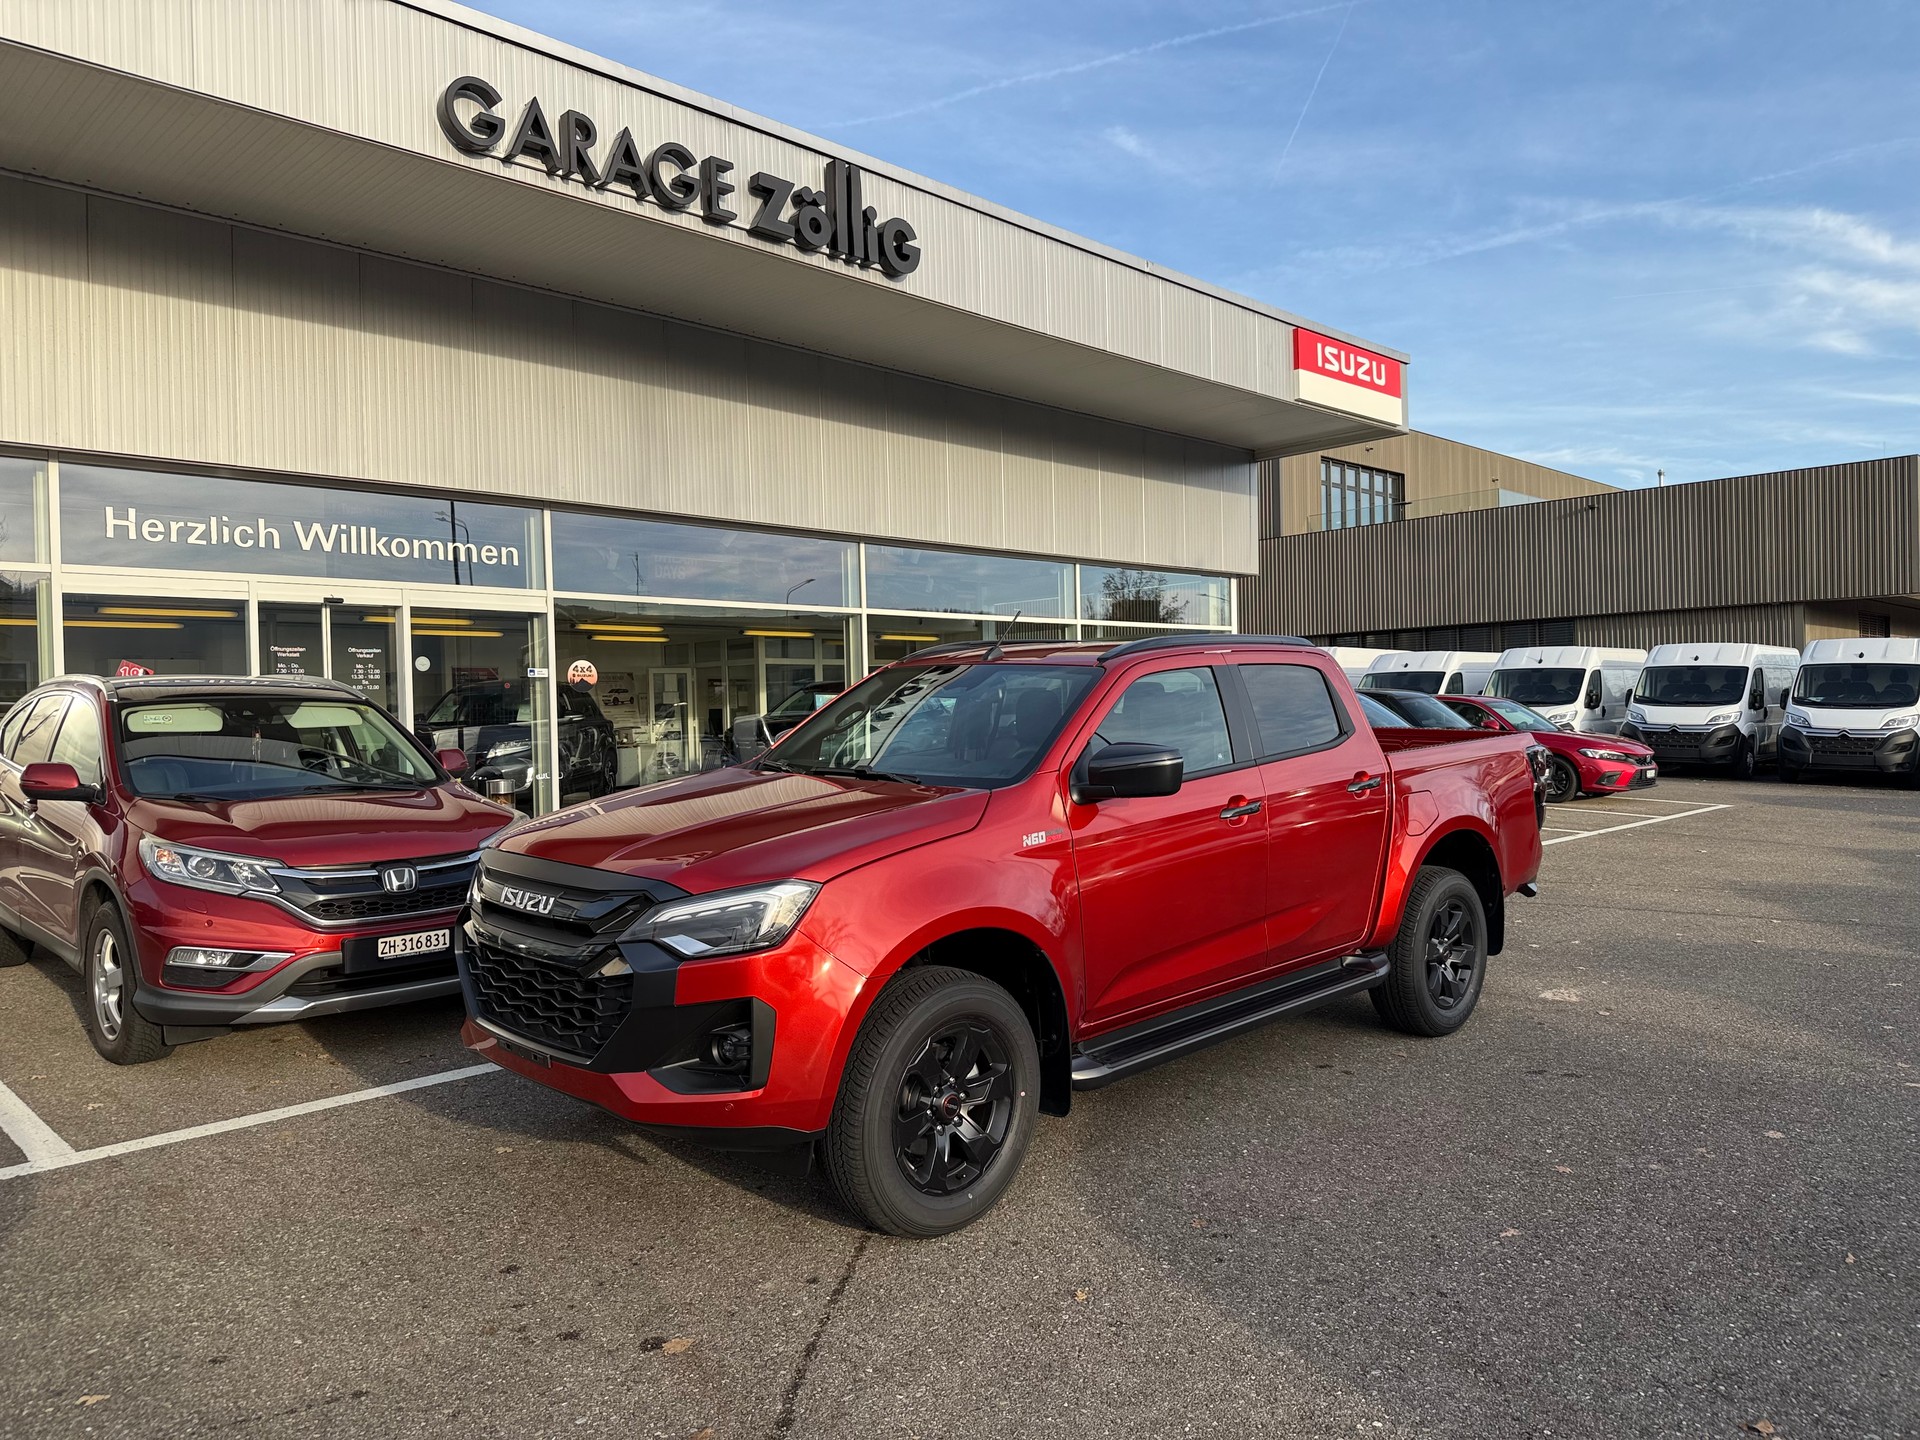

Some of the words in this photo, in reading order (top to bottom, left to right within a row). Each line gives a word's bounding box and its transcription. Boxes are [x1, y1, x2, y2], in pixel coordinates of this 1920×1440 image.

[437, 76, 737, 223] GARAGE
[1316, 342, 1386, 387] ISUZU
[105, 505, 280, 550] Herzlich
[293, 520, 519, 566] Willkommen
[572, 665, 593, 673] 4x4
[1022, 831, 1046, 848] N60
[500, 886, 555, 914] ISUZU
